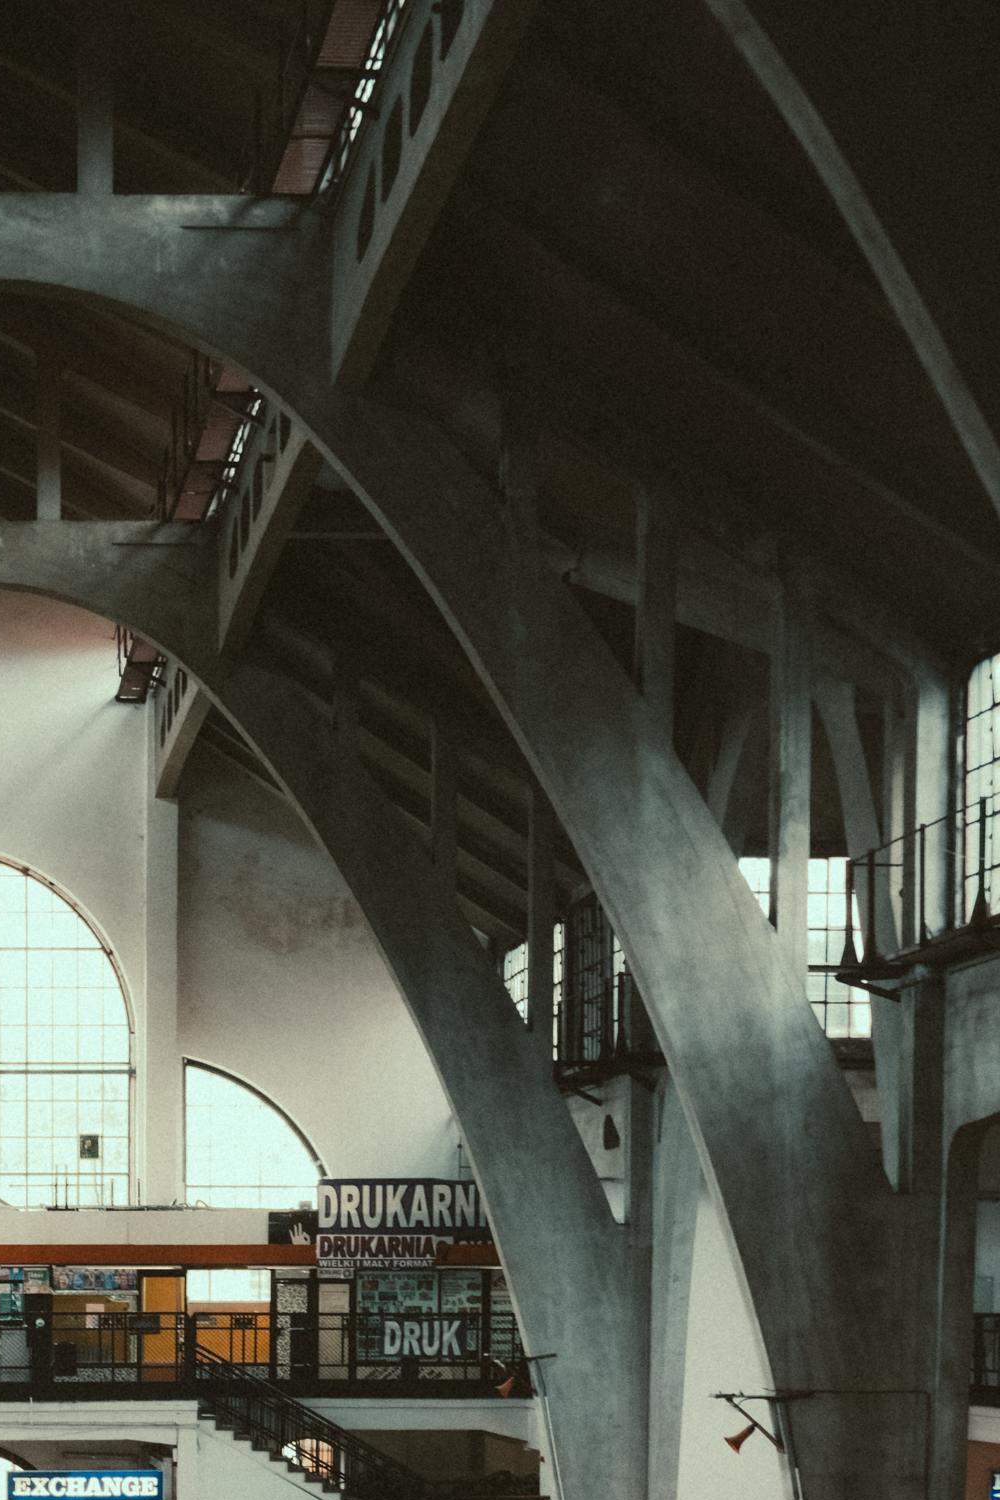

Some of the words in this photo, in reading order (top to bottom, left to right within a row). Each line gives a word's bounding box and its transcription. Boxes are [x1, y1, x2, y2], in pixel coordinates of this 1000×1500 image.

[319, 1235, 437, 1258] DRUKARNIA
[318, 1259, 354, 1268] WIELKI
[363, 1259, 390, 1268] MAŁY
[393, 1259, 434, 1268] FORMAT
[384, 1320, 462, 1356] DRUK
[12, 1476, 159, 1498] EXCHANGE
